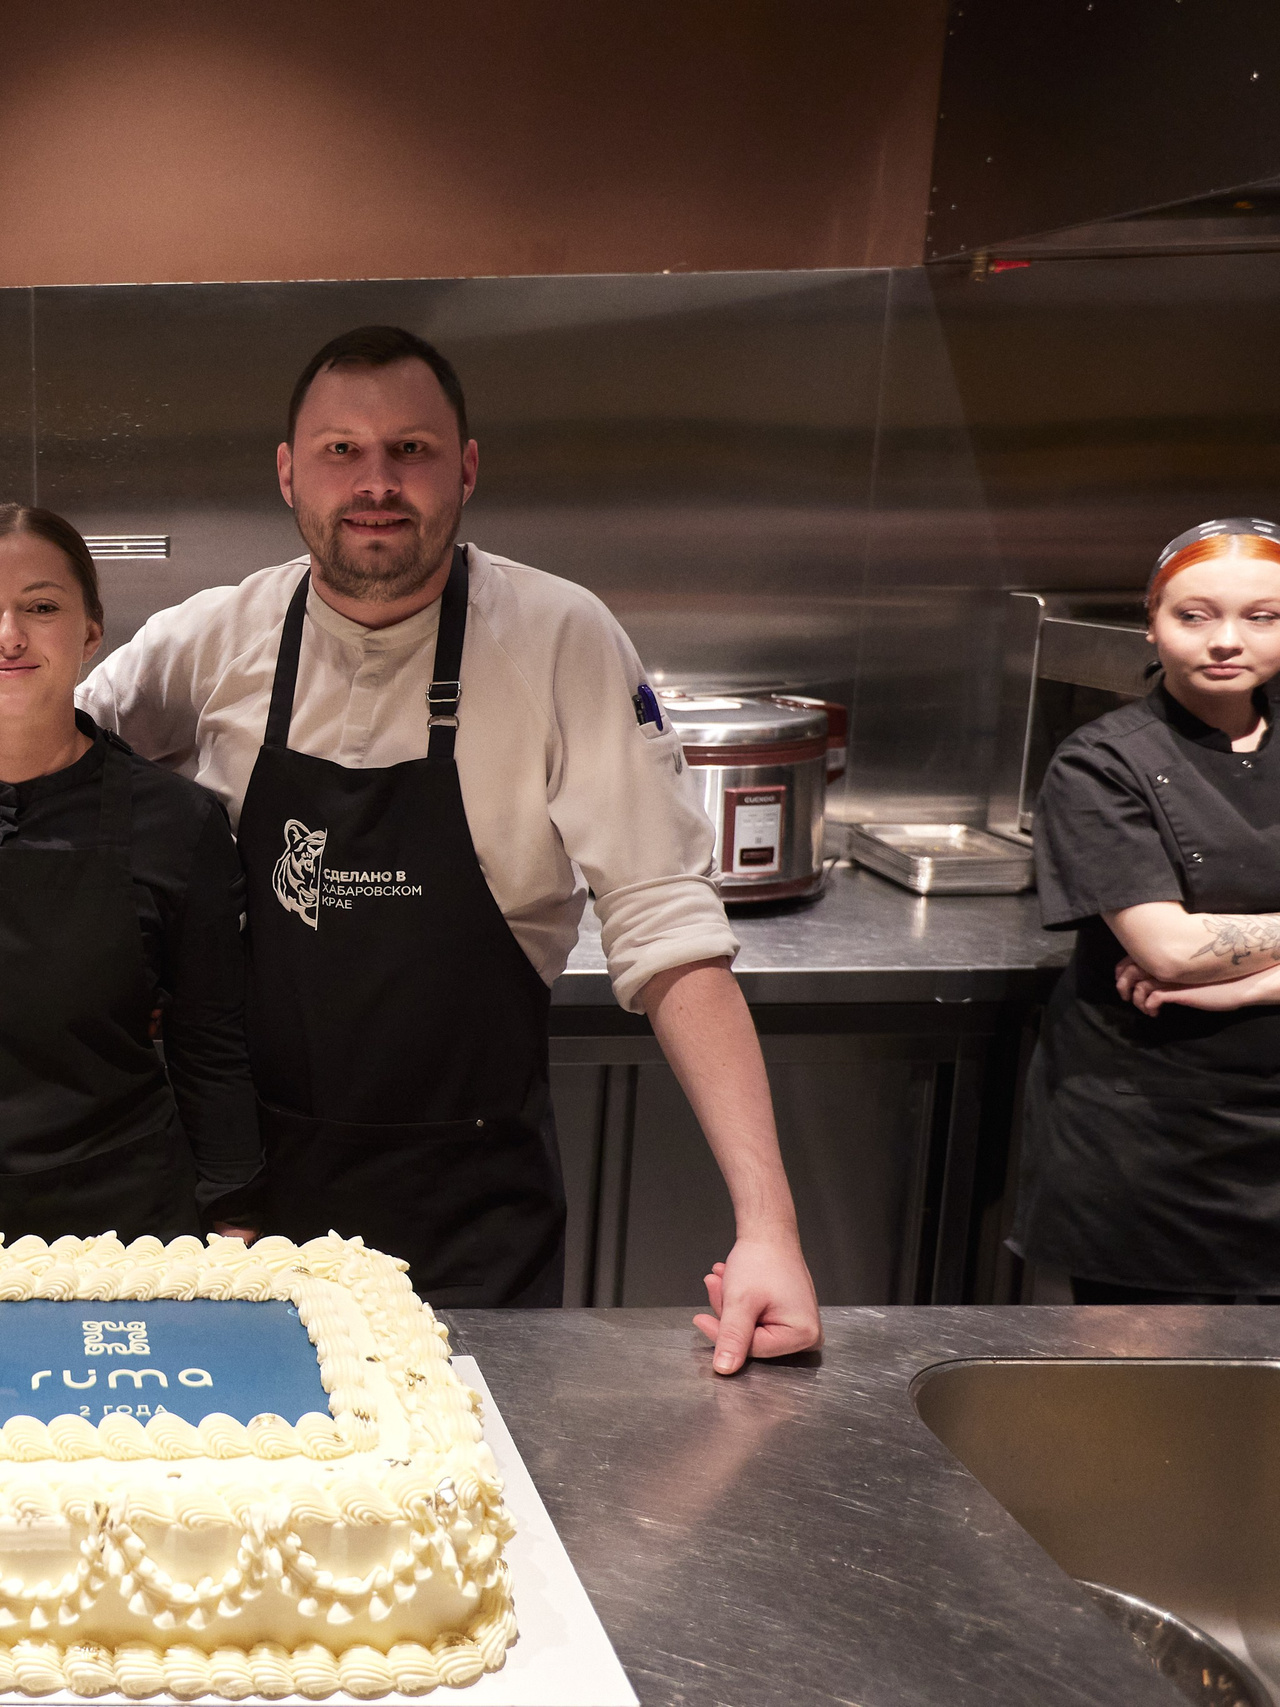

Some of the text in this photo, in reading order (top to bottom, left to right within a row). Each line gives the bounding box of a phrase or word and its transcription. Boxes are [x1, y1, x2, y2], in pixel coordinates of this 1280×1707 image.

[323, 868, 406, 883] СДЕЛАНО В
[322, 882, 422, 896] ХАБАРОВСКОМ
[321, 895, 352, 909] КРАЕ
[31, 1368, 214, 1390] ruma
[79, 1404, 168, 1417] 2 ГОДА
